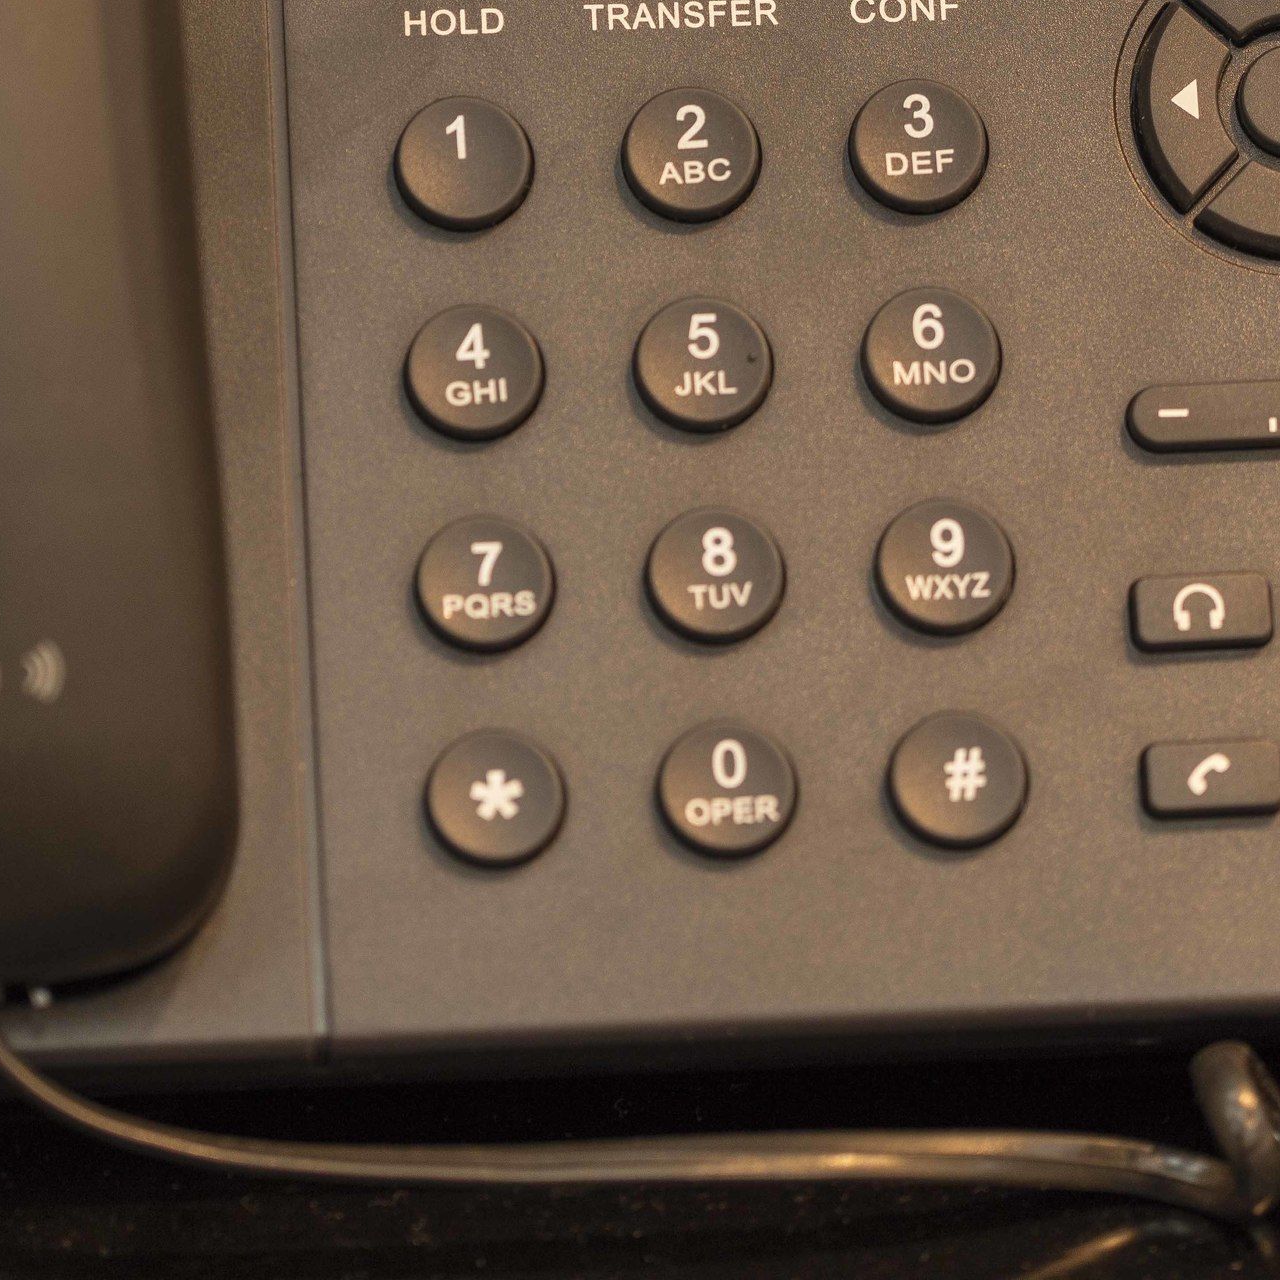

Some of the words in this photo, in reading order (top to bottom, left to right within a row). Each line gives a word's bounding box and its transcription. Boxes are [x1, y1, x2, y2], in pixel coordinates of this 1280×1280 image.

[402, 8, 506, 38] HOLD
[675, 105, 709, 150] 2
[902, 94, 934, 139] 3
[444, 115, 468, 159] 1
[659, 158, 732, 186] ABC
[885, 149, 955, 176] DEF
[687, 313, 720, 358] 5
[911, 304, 945, 350] 6
[455, 324, 489, 369] 4
[674, 370, 738, 397] JKL
[892, 358, 976, 386] MNO
[445, 378, 508, 406] GHI
[701, 527, 737, 577] 8
[930, 518, 965, 567] 9
[470, 541, 503, 587] 7
[687, 582, 753, 611] TUV
[904, 571, 991, 602] WXYZ
[442, 591, 537, 620] PQRS
[685, 796, 780, 826] OPER
